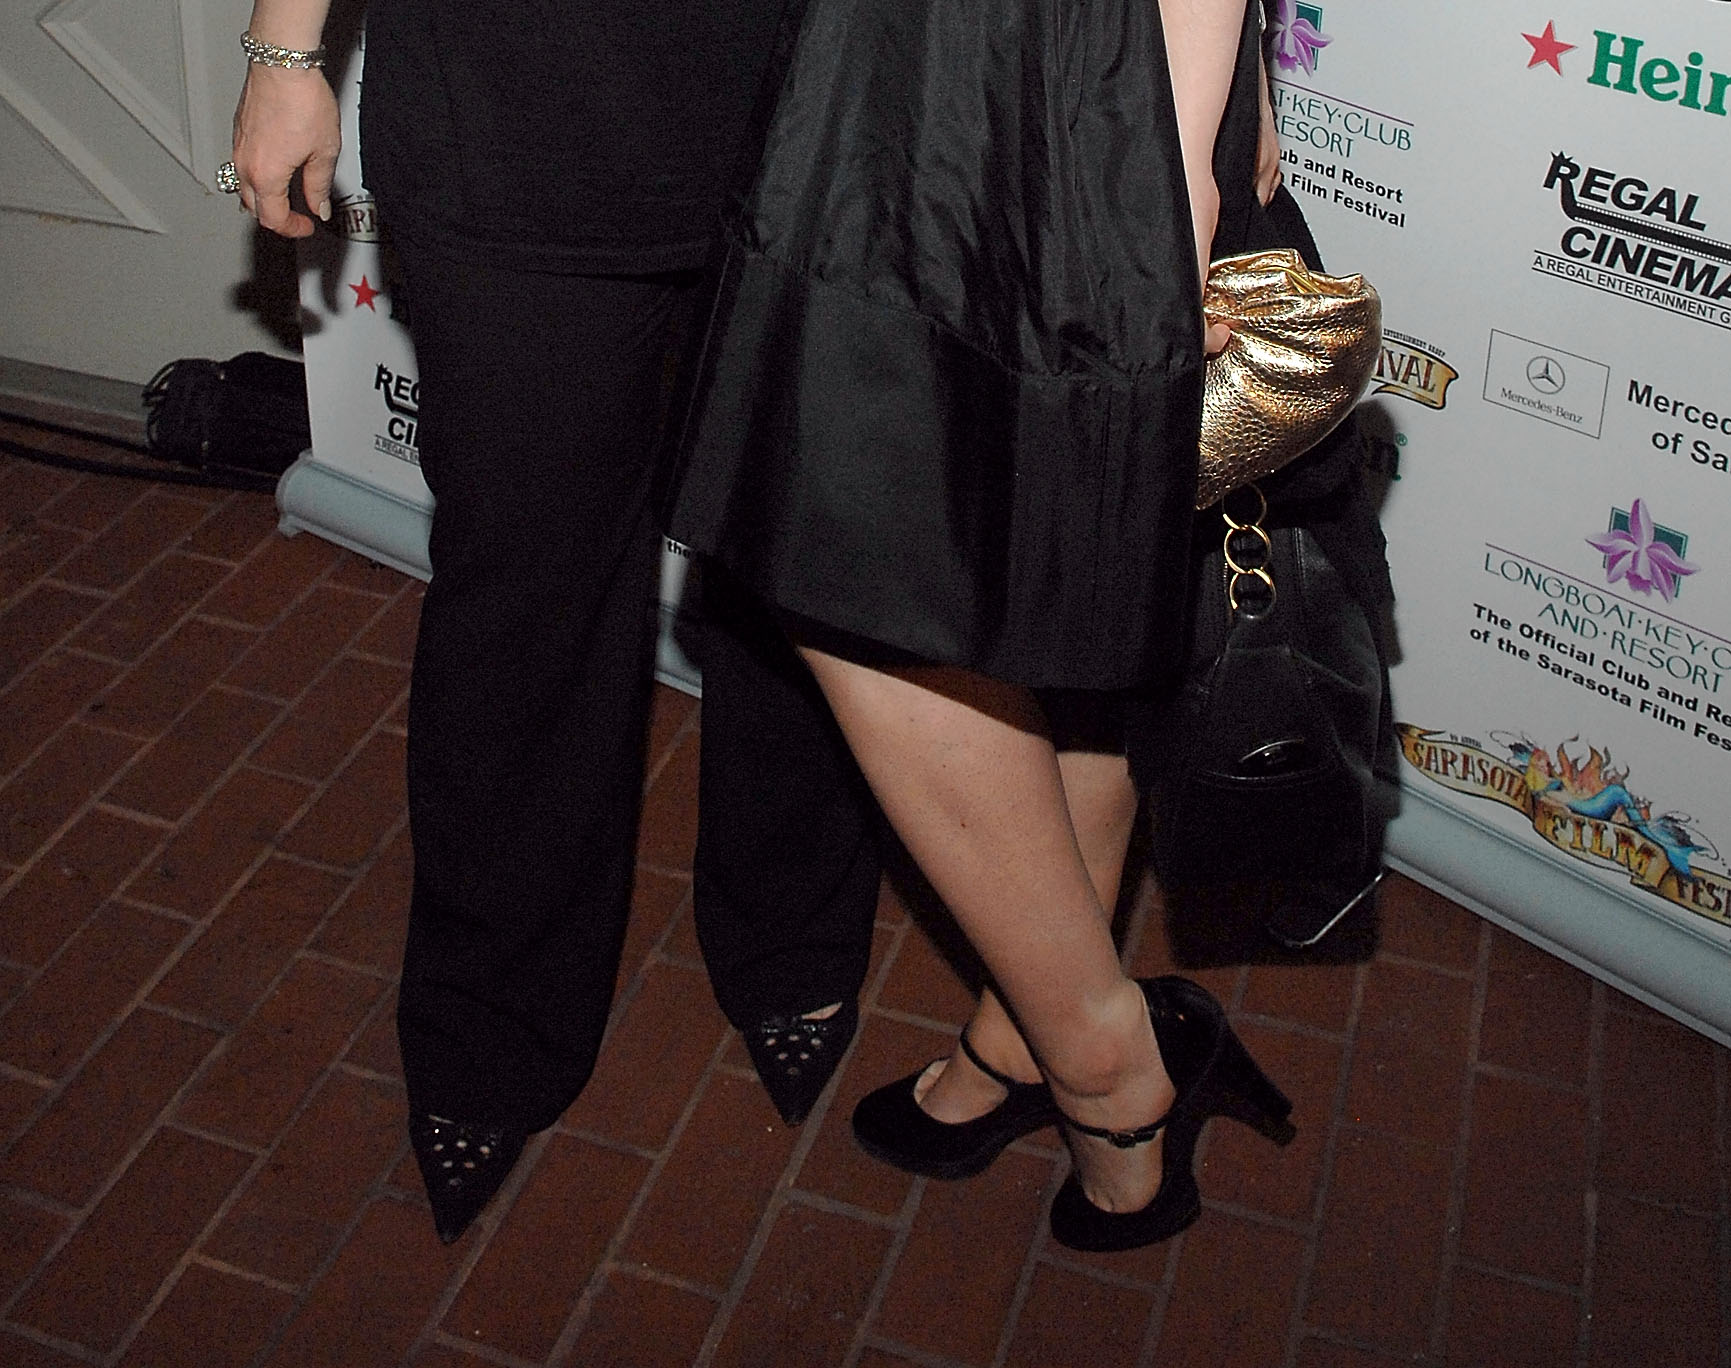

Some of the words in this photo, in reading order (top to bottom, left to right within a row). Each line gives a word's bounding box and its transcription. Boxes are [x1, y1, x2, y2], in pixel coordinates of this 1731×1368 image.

[1291, 173, 1327, 199] Film
[1333, 188, 1405, 228] Festival
[1304, 158, 1336, 179] and
[1342, 168, 1403, 203] Resort
[1543, 150, 1706, 232] REGAL
[1534, 255, 1543, 268] A
[1546, 260, 1593, 283] REGAL
[1598, 273, 1717, 320] ENTERTAINMENT
[1500, 387, 1583, 424] Mercedes-Benz
[1652, 432, 1683, 454] of
[1470, 628, 1491, 645] of
[1497, 637, 1530, 661] the
[1537, 652, 1631, 707] Sarasota
[1639, 698, 1686, 731] Film
[1473, 603, 1512, 630] The
[1518, 622, 1595, 667] Official
[1602, 658, 1650, 691] Club
[1656, 684, 1699, 712] and
[1412, 741, 1529, 810] SARASOTA
